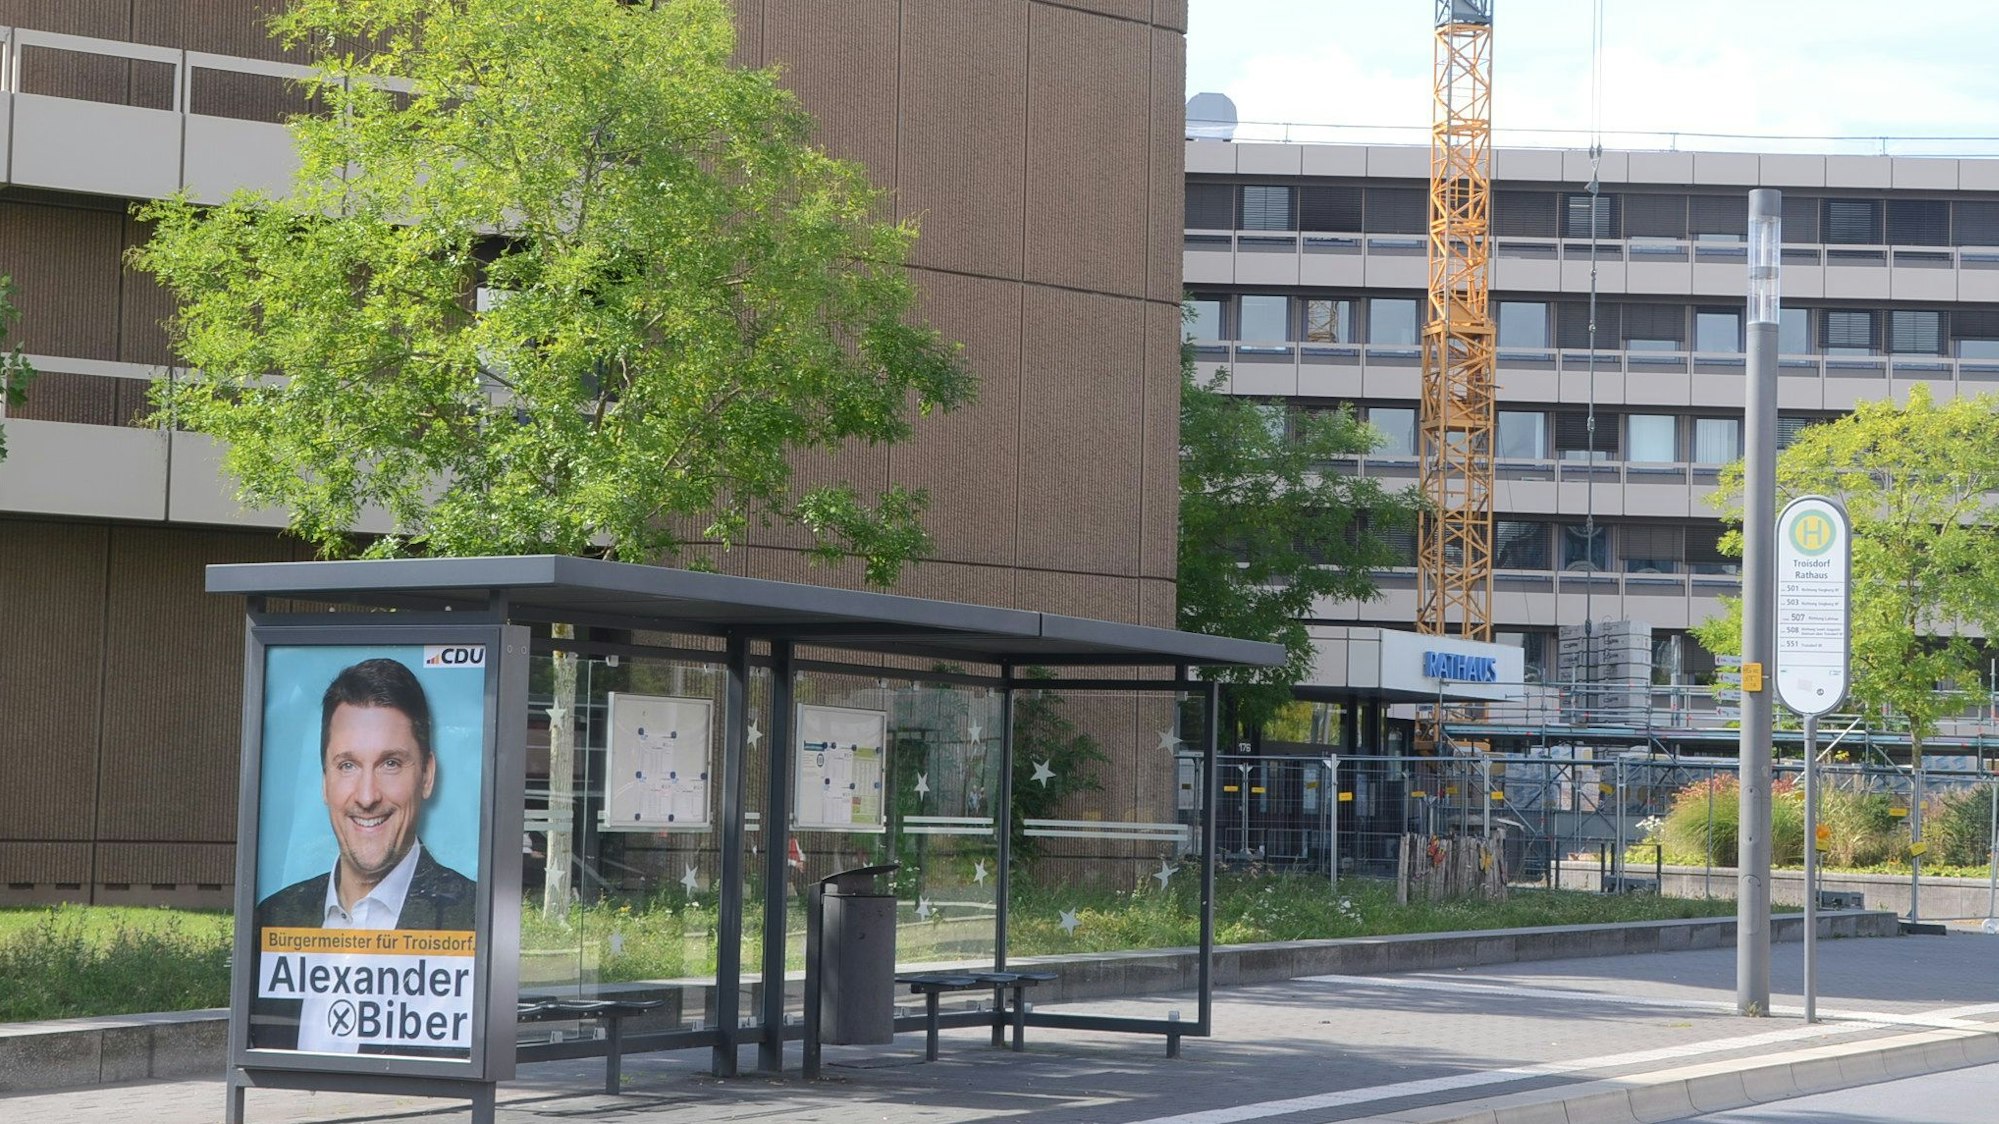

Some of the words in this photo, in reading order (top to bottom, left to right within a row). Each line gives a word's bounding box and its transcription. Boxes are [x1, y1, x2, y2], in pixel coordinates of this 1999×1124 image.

[1803, 520, 1822, 546] H
[1793, 559, 1831, 568] Troisdorf
[1795, 571, 1828, 579] Rathaus
[1786, 584, 1799, 592] 501
[1786, 598, 1799, 606] 503
[1791, 613, 1805, 621] 507
[441, 648, 484, 665] CDU
[1423, 651, 1497, 682] RATHAUS
[1238, 742, 1252, 752] 176
[268, 932, 371, 951] Bürgermeister
[376, 933, 398, 949] für
[268, 955, 469, 997] Alexander
[357, 1000, 468, 1041] Biber
